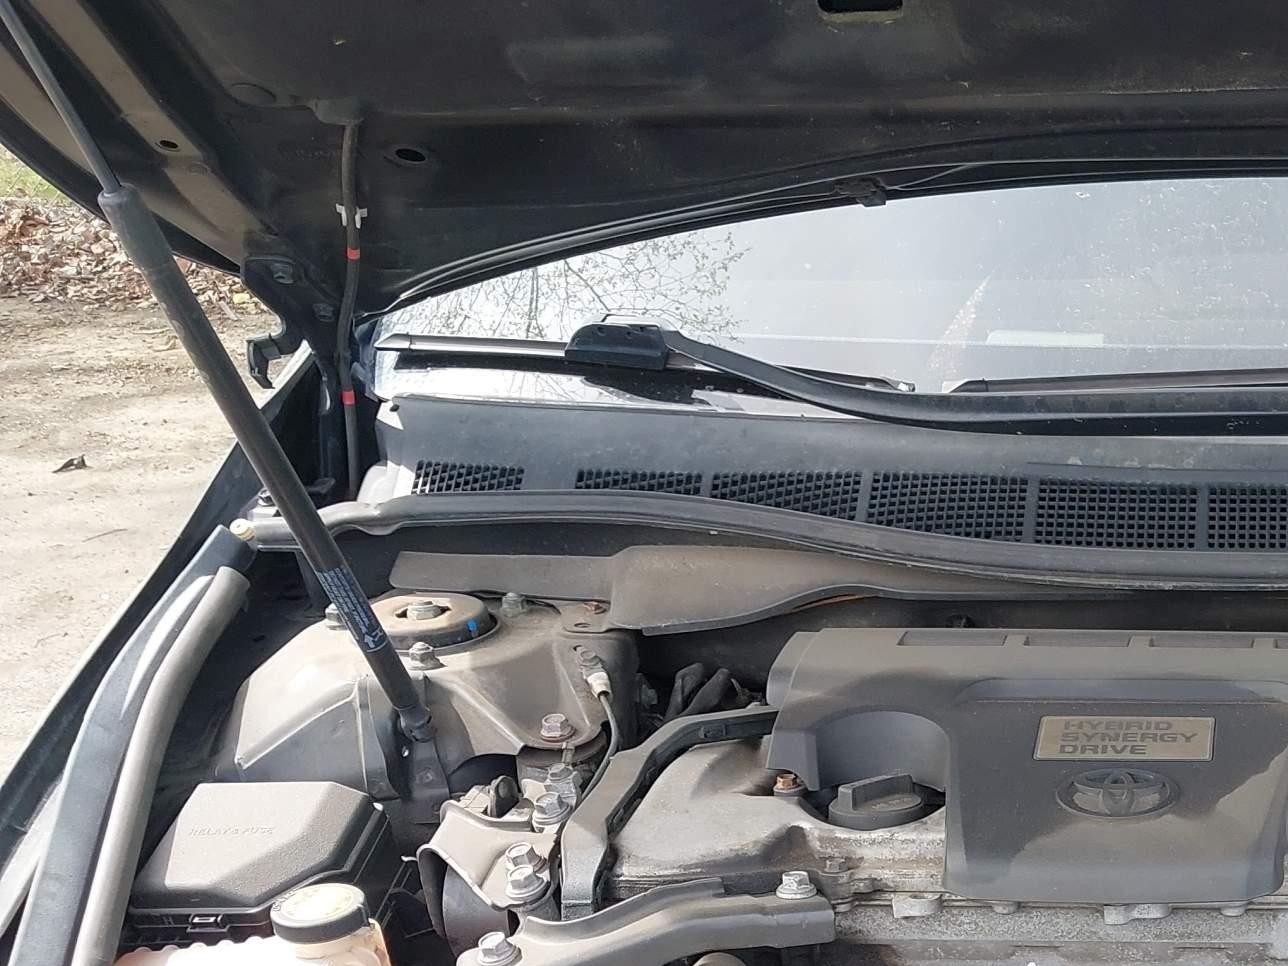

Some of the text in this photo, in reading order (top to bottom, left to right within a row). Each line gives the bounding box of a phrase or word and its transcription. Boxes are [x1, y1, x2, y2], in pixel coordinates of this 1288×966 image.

[1063, 720, 1173, 731] HYBRID
[1060, 732, 1198, 743] SYNERGY
[1057, 744, 1147, 755] DRIVE
